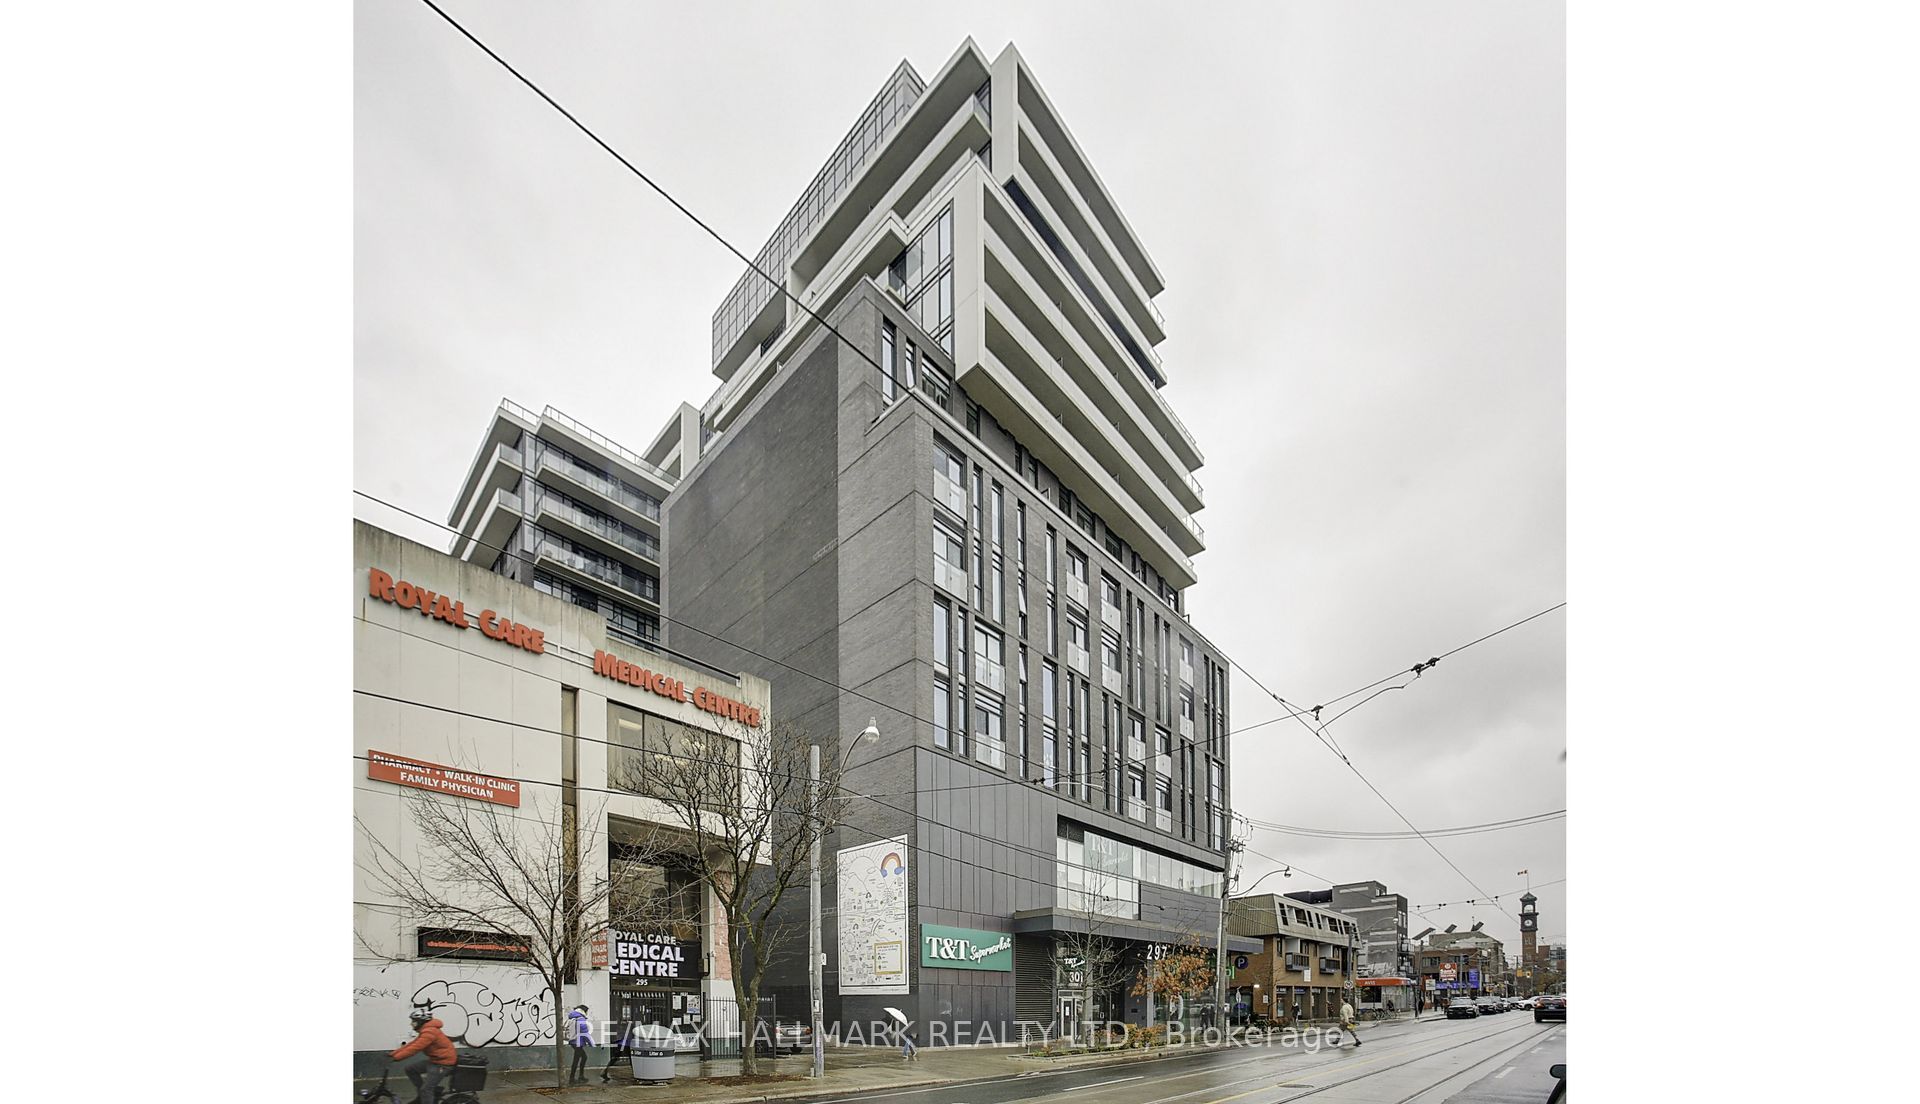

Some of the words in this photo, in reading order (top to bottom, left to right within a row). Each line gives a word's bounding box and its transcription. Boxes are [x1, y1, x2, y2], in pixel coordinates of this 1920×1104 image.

[370, 567, 469, 629] ROYAL
[479, 609, 545, 655] CARE
[593, 649, 688, 703] MEDICAL
[693, 687, 761, 727] CENTRE
[400, 771, 439, 787] FAMILY
[441, 780, 494, 798] PHYSICIAN
[444, 770, 486, 785] WALK-IN
[487, 778, 516, 792] CLINIC
[615, 931, 644, 942] OYAL
[647, 934, 676, 945] CARE
[617, 942, 684, 962] EDICAL
[925, 936, 970, 960] T&T
[969, 936, 1011, 964] Supermarket
[1147, 944, 1167, 960] 297
[635, 978, 648, 986] 295
